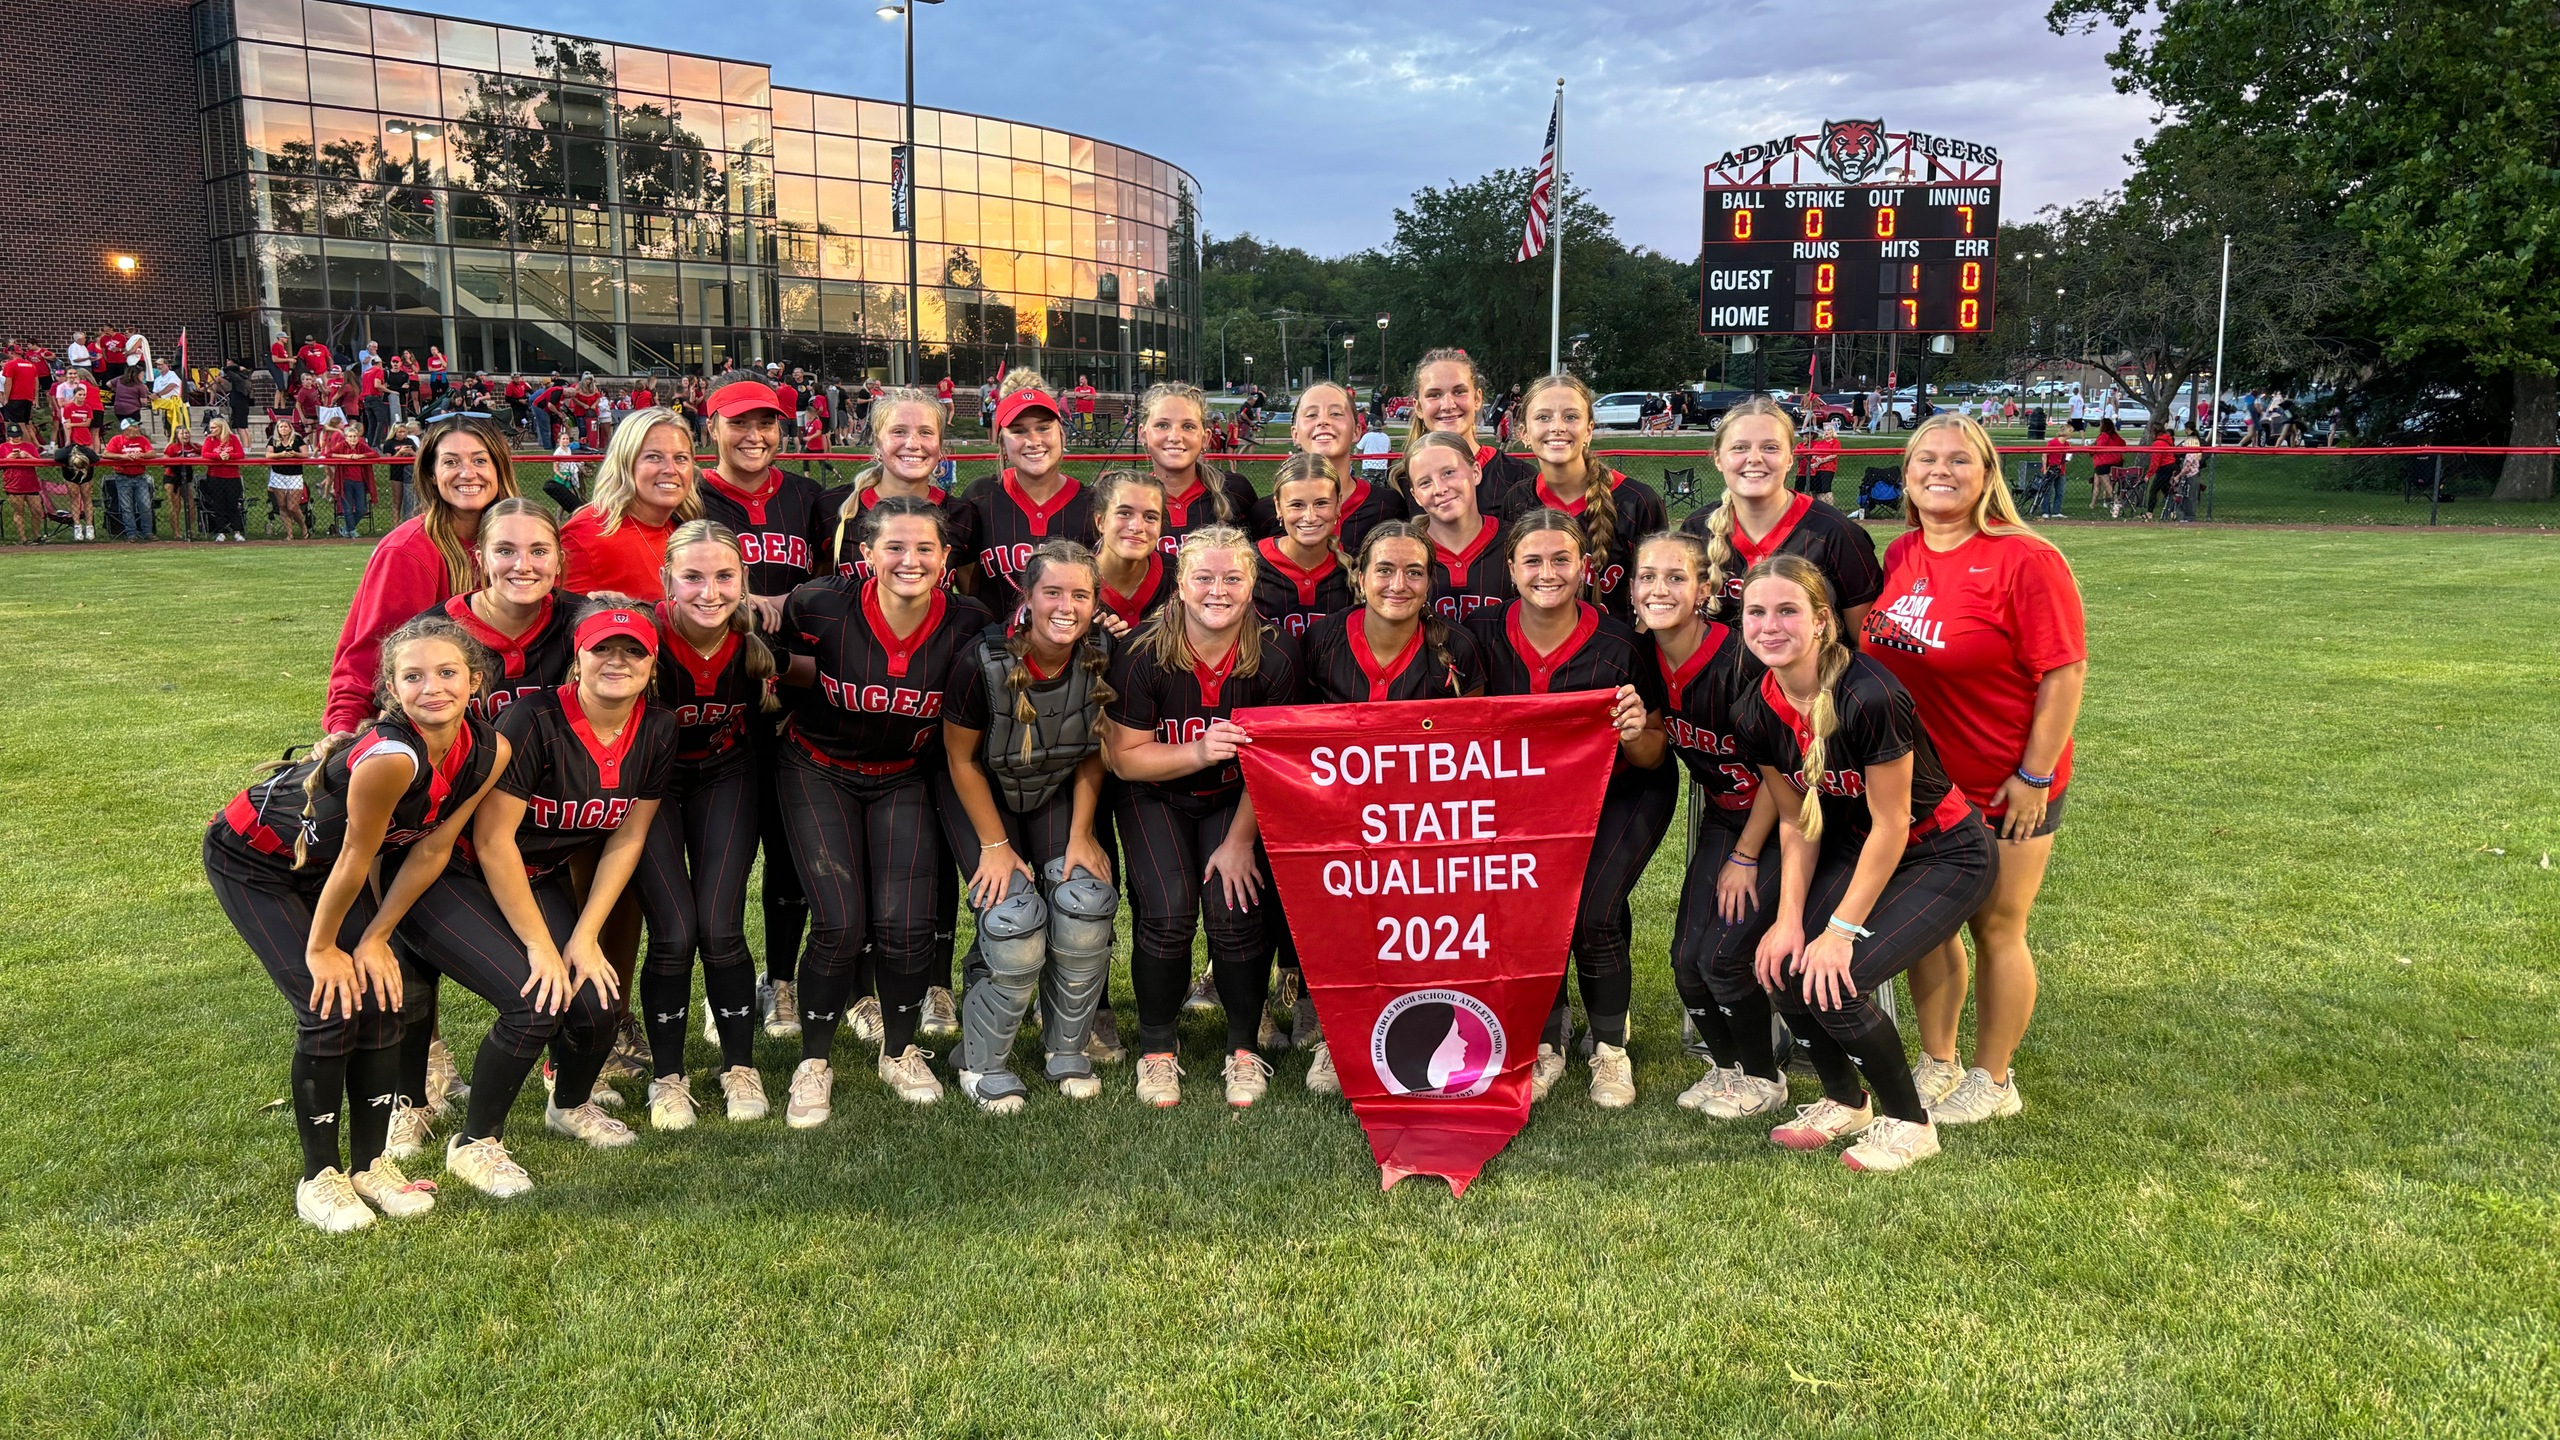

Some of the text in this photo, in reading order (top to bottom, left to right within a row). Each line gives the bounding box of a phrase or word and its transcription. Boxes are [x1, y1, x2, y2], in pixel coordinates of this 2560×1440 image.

[1715, 134, 1796, 172] ADM
[1908, 130, 1999, 167] TIGERS
[897, 192, 906, 226] ADM
[1722, 191, 1765, 209] BALL
[1785, 190, 1845, 208] STRIKE
[1868, 189, 1905, 207] OUT
[1929, 187, 1991, 206] INNING
[1734, 209, 1752, 239] 0
[1805, 208, 1823, 238] 0
[1877, 207, 1895, 237] 0
[1957, 206, 1973, 235] 7
[1793, 241, 1840, 259] RUNS
[1881, 240, 1920, 257] HITS
[1955, 239, 1989, 257] ERR
[1710, 270, 1773, 291] GUEST
[1817, 263, 1835, 293] 0
[1911, 264, 1920, 290] 1
[1962, 262, 1981, 292] 0
[1711, 306, 1769, 327] HOME
[1815, 299, 1834, 329] 6
[1902, 299, 1917, 327] 7
[1959, 299, 1978, 328] 0
[736, 532, 814, 574] GER
[1887, 595, 1934, 618] ADM
[1862, 609, 1946, 649] SOFTBALL
[1870, 635, 1924, 654] TIGERS
[819, 671, 943, 719] TIGER
[676, 702, 747, 727] GER
[1664, 716, 1736, 755] ERS
[1310, 737, 1545, 787] SOFTBALL
[528, 795, 638, 829] TIGE
[1361, 799, 1497, 844] STATE
[1323, 853, 1538, 898] QUALIFIER
[1376, 913, 1490, 962] 2024
[1375, 992, 1502, 1062] IOWA GIRLS HIGH SCHOOL ATHLETIC UNION
